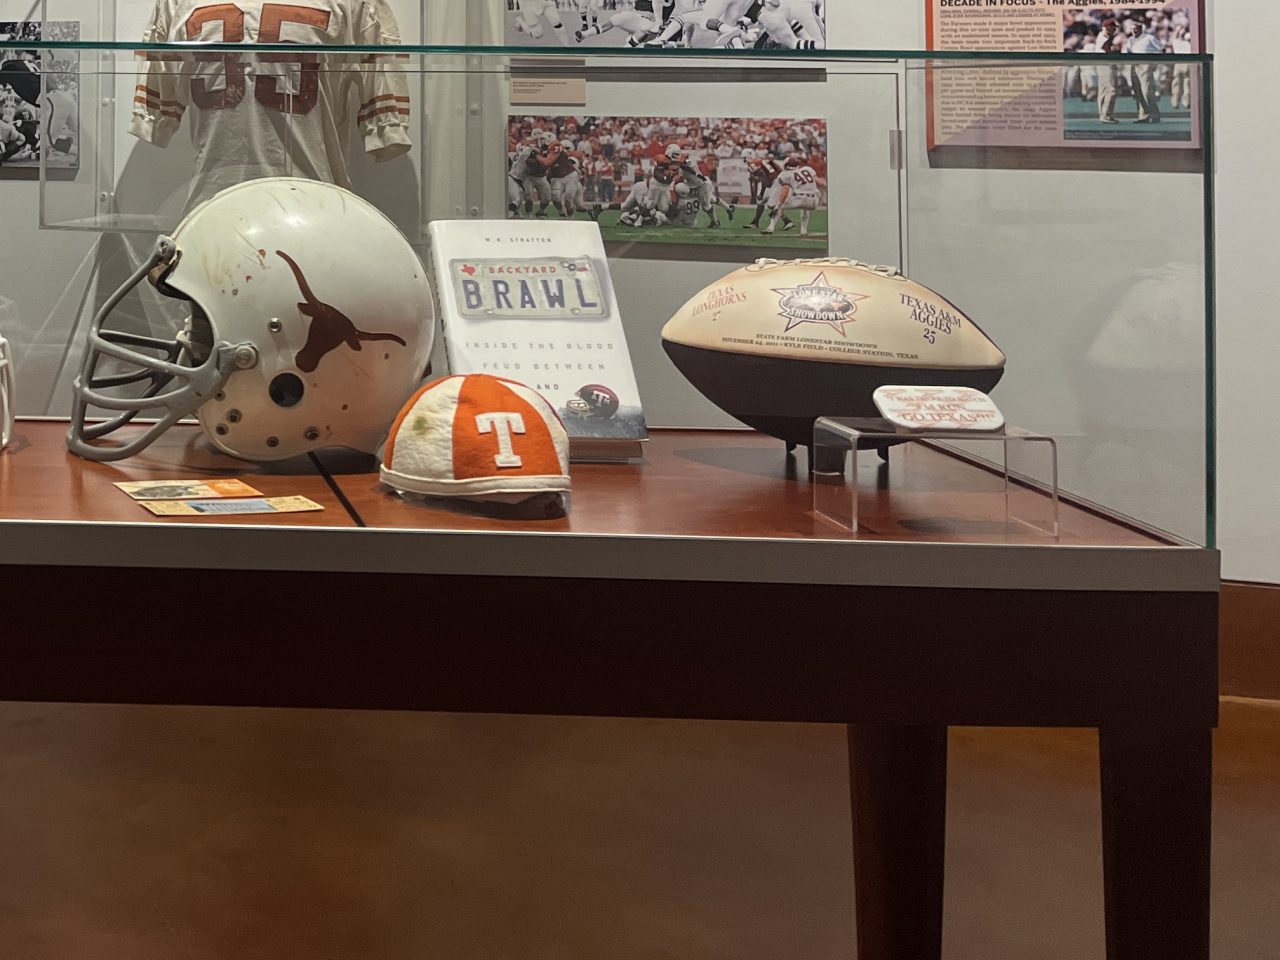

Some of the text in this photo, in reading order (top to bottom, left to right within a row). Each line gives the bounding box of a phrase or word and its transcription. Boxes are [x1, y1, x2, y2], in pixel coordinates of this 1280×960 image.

[185, 2, 332, 117] 35
[488, 265, 557, 274] BACKYARD
[462, 279, 598, 310] BRAWL
[692, 291, 748, 317] LONGHORNS
[899, 293, 962, 329] TEXAS A&M
[789, 308, 845, 321] SHOWDOWN
[909, 308, 952, 335] AGGIES
[923, 327, 936, 345] 25
[465, 342, 614, 350] INSIDE THE BLOOD
[829, 346, 861, 355] COLLEGE
[482, 362, 521, 370] FEUD
[536, 383, 560, 391] AND
[475, 411, 526, 468] T
